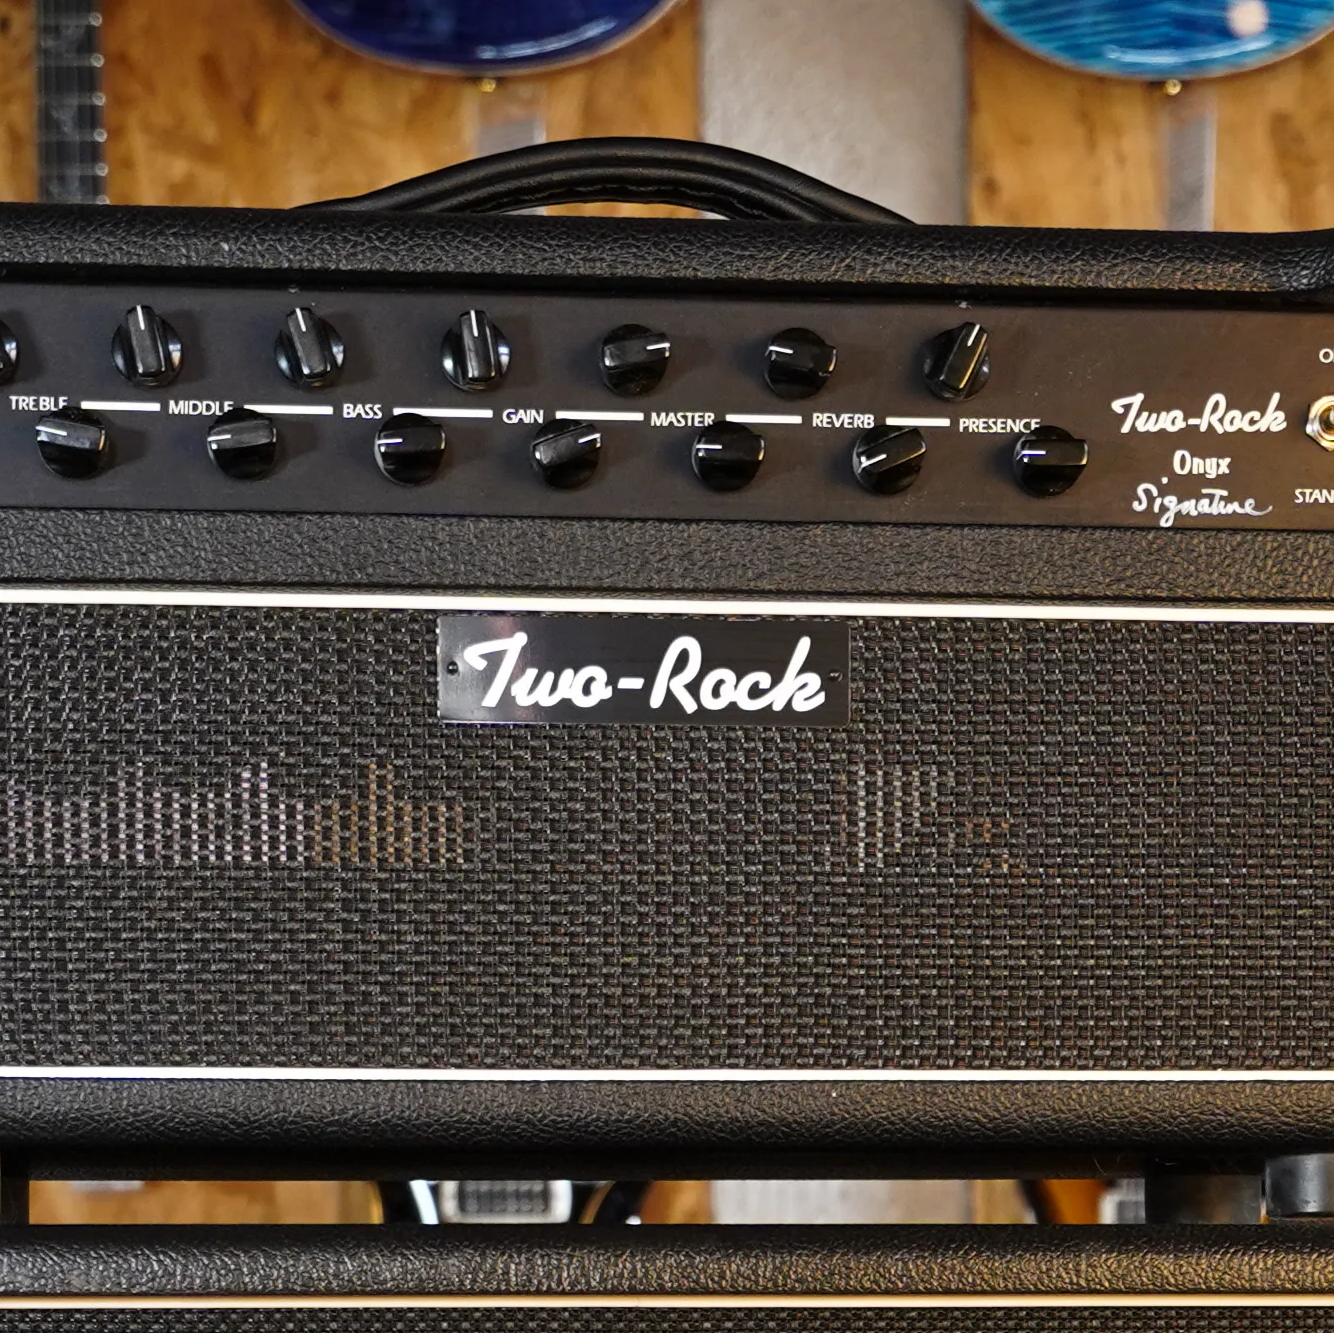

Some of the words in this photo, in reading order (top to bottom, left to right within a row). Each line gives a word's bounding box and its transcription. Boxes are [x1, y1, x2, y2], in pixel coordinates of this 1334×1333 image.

[9, 396, 68, 411] TREBLE
[169, 400, 234, 416] MIDDLE
[343, 404, 382, 419] BASS
[502, 409, 544, 424] GAIN
[650, 412, 715, 427] MASTER
[812, 413, 875, 428] REVERB
[959, 418, 1041, 433] PRESENCE
[1111, 392, 1288, 434] Two-Rock
[1173, 450, 1232, 478] Onyx
[463, 631, 826, 715] Two-Rock
